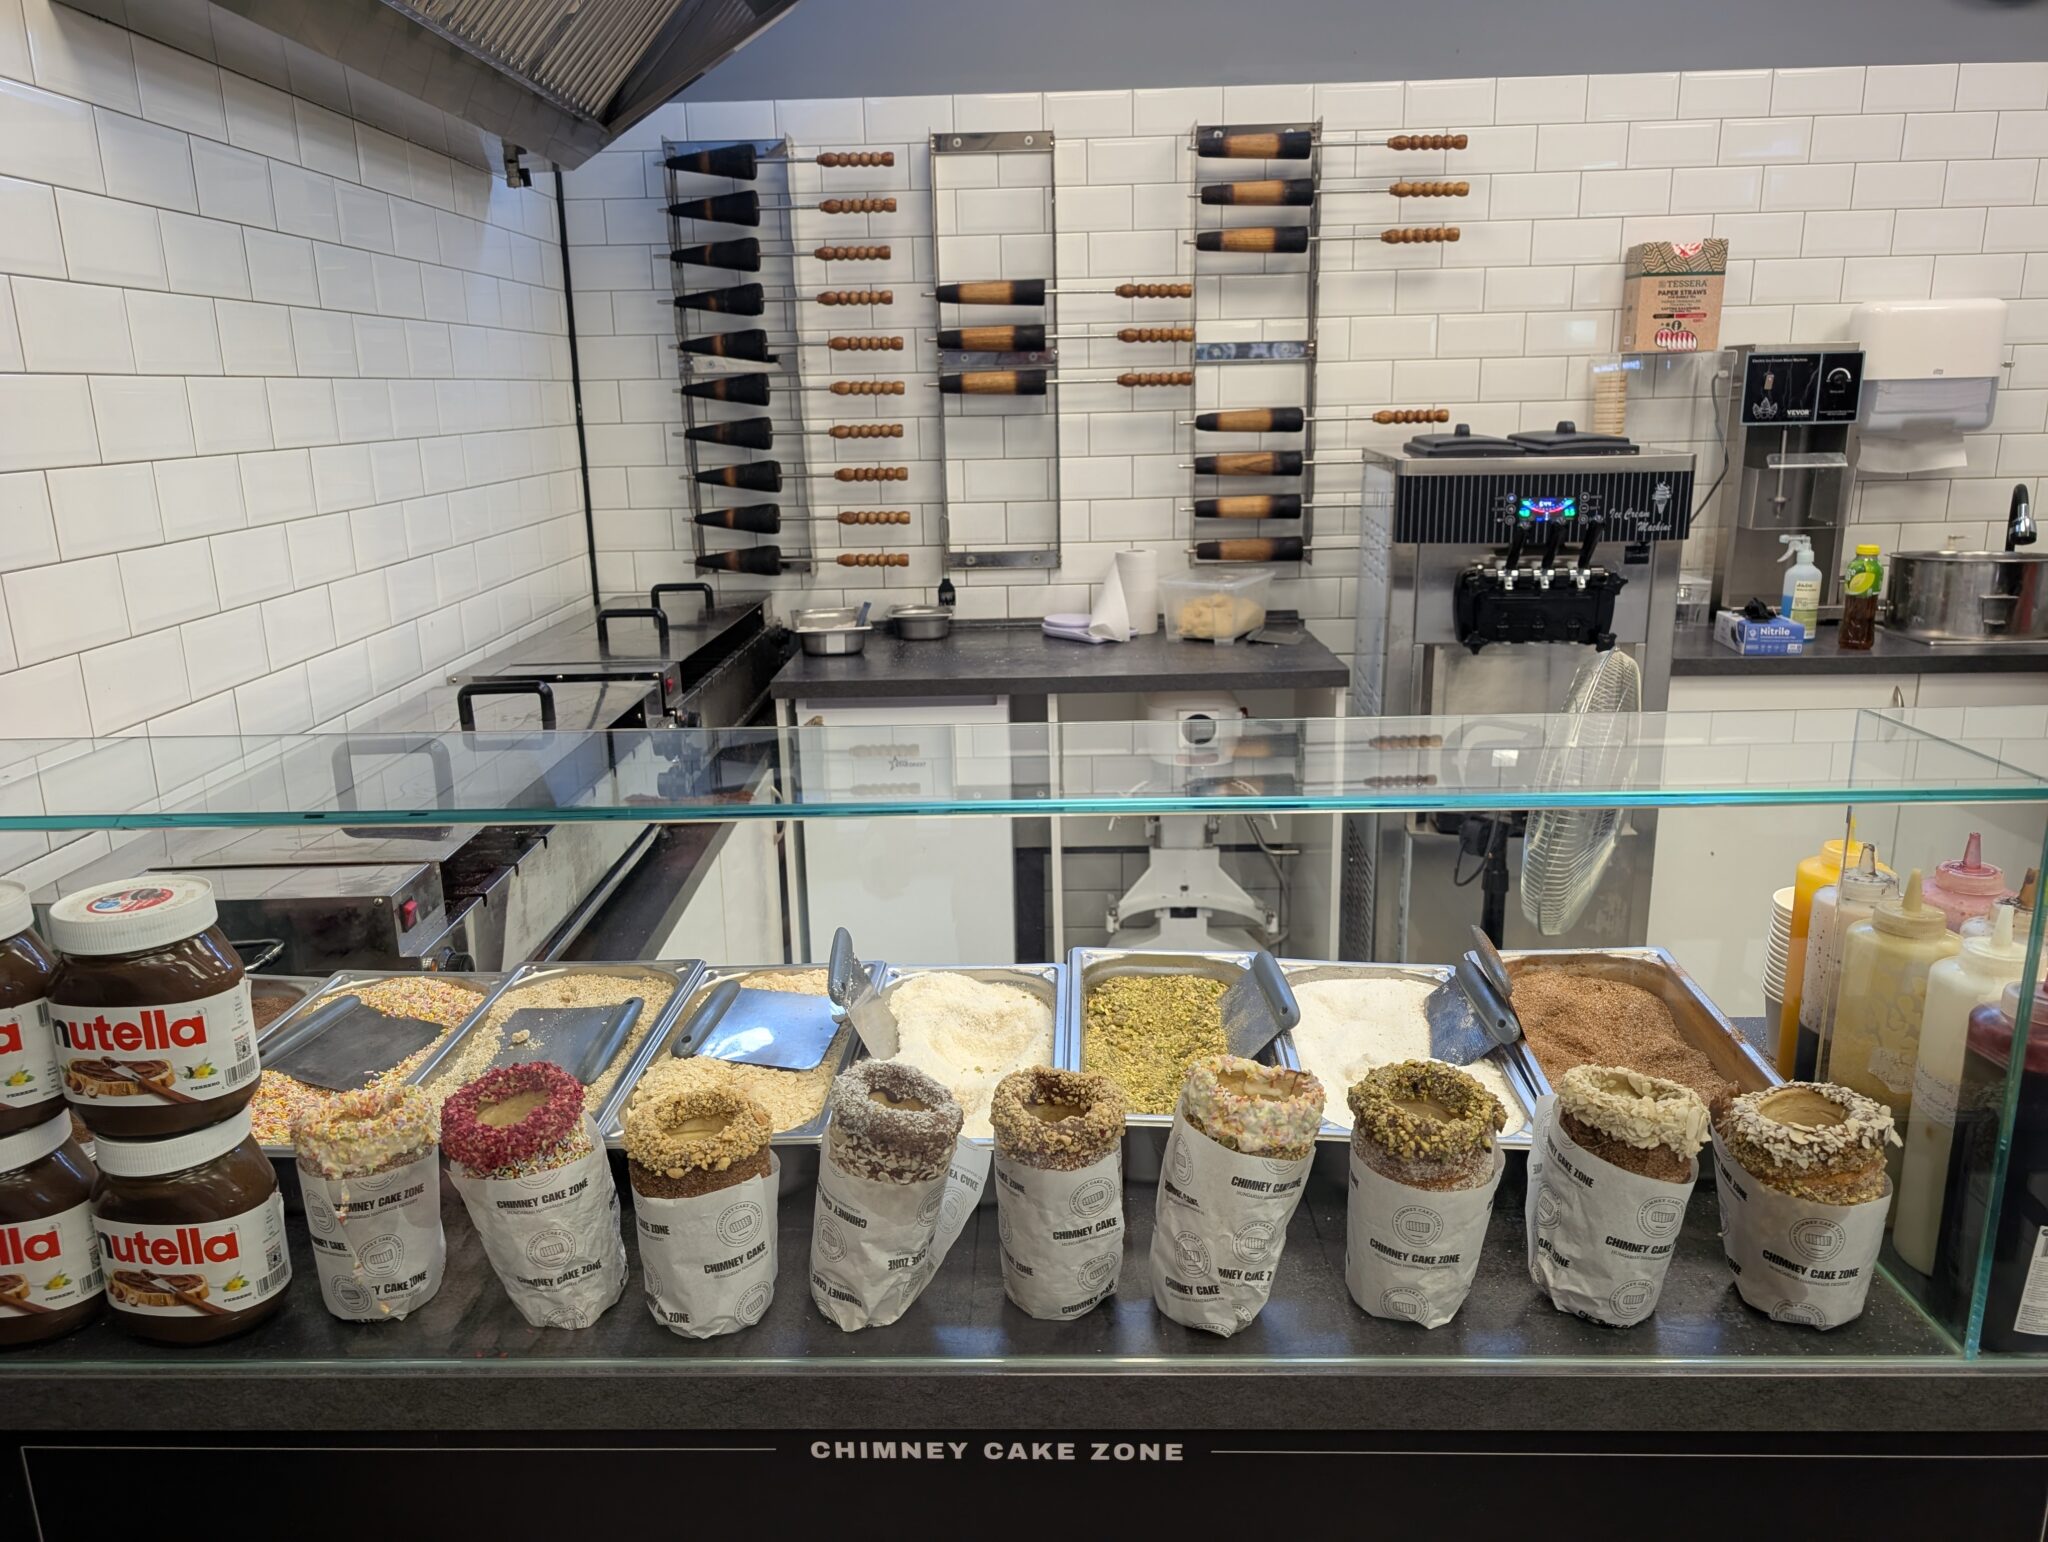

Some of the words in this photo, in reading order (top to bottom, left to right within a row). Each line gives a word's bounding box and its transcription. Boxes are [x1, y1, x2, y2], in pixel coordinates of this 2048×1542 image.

[1667, 280, 1707, 288] TESSERA
[1609, 508, 1622, 518] Ice
[1624, 508, 1650, 520] Cream
[1637, 521, 1672, 532] Machine
[1760, 627, 1790, 636] Nitrile
[53, 1010, 207, 1051] nutella
[1557, 1152, 1573, 1174] CAKE
[1574, 1167, 1594, 1188] ZONE
[496, 1197, 539, 1209] CHIMNEY
[541, 1189, 566, 1203] CAKE
[569, 1178, 588, 1198] ZONE
[1009, 1178, 1026, 1195] ZONE
[1231, 1176, 1272, 1192] CHIMNEY
[378, 1193, 402, 1208] CAKE
[404, 1183, 424, 1198] ZONE
[834, 1206, 867, 1229] CHIMNEY
[650, 1223, 670, 1235] ZONE
[1053, 1225, 1093, 1241] CHIMNEY
[1096, 1217, 1117, 1232] CAKE
[97, 1228, 239, 1265] nutella
[1370, 1238, 1409, 1262] CHIMNEY
[1412, 1254, 1436, 1265] CAKE
[1438, 1254, 1460, 1264] ZONE
[1605, 1236, 1650, 1254] CHIMNEY
[1651, 1243, 1672, 1254] CAKE
[704, 1255, 744, 1274] CHIMNEY
[747, 1241, 766, 1260] CAKE
[888, 1257, 910, 1271] ZONE
[912, 1248, 927, 1266] CAKE
[1552, 1249, 1570, 1268] ZONE
[1762, 1249, 1808, 1273] CHIMNEY
[1810, 1269, 1835, 1280] CAKE
[1838, 1268, 1859, 1279] ZONE
[517, 1275, 553, 1287] CHIMNEY
[557, 1269, 579, 1285] CAKE
[581, 1259, 602, 1275] ZONE
[1016, 1260, 1034, 1276] ZONE
[1245, 1270, 1264, 1282] CAKE
[384, 1281, 409, 1294] CAKE
[409, 1271, 427, 1288] ZONE
[812, 1273, 827, 1292] CAKE
[1197, 1284, 1220, 1296] CAKE
[828, 1286, 862, 1308] CHIMNEY
[1062, 1296, 1098, 1314] CHIMNEY
[669, 1312, 690, 1323] ZONE
[810, 1441, 969, 1460] CHIMNEY
[983, 1442, 1076, 1461] CAKE
[1090, 1443, 1184, 1462] ZONE
